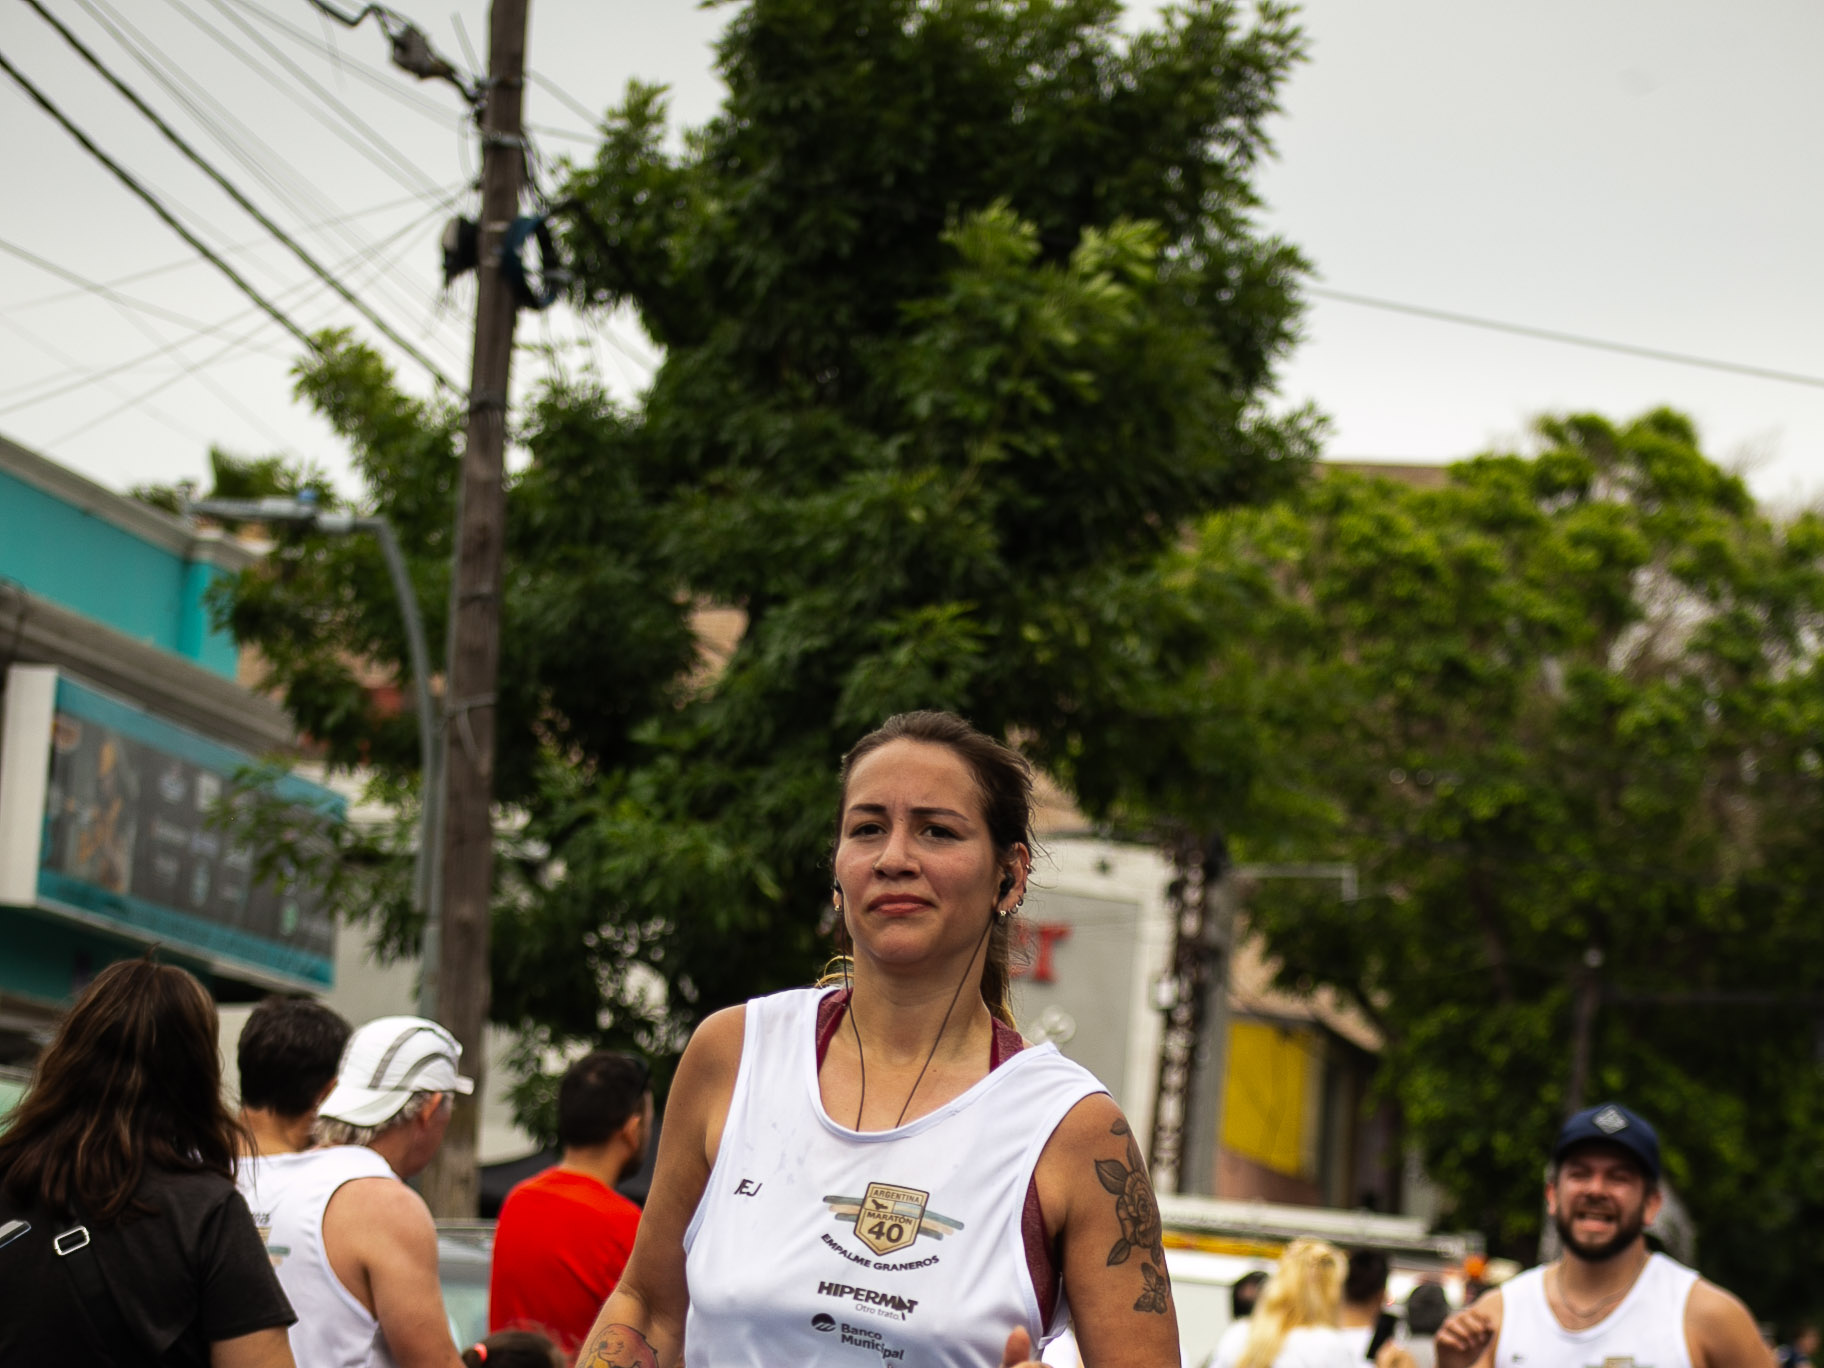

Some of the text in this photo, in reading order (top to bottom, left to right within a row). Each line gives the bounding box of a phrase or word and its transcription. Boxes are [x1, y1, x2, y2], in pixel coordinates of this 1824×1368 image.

[873, 1189, 920, 1203] ARGENTINA
[866, 1211, 913, 1226] MARATÓN
[867, 1221, 904, 1243] 40
[820, 1233, 940, 1271] EMPALME GRANEROS
[855, 1303, 876, 1314] Otro
[841, 1323, 882, 1340] Banco
[841, 1334, 904, 1360] Municipal
